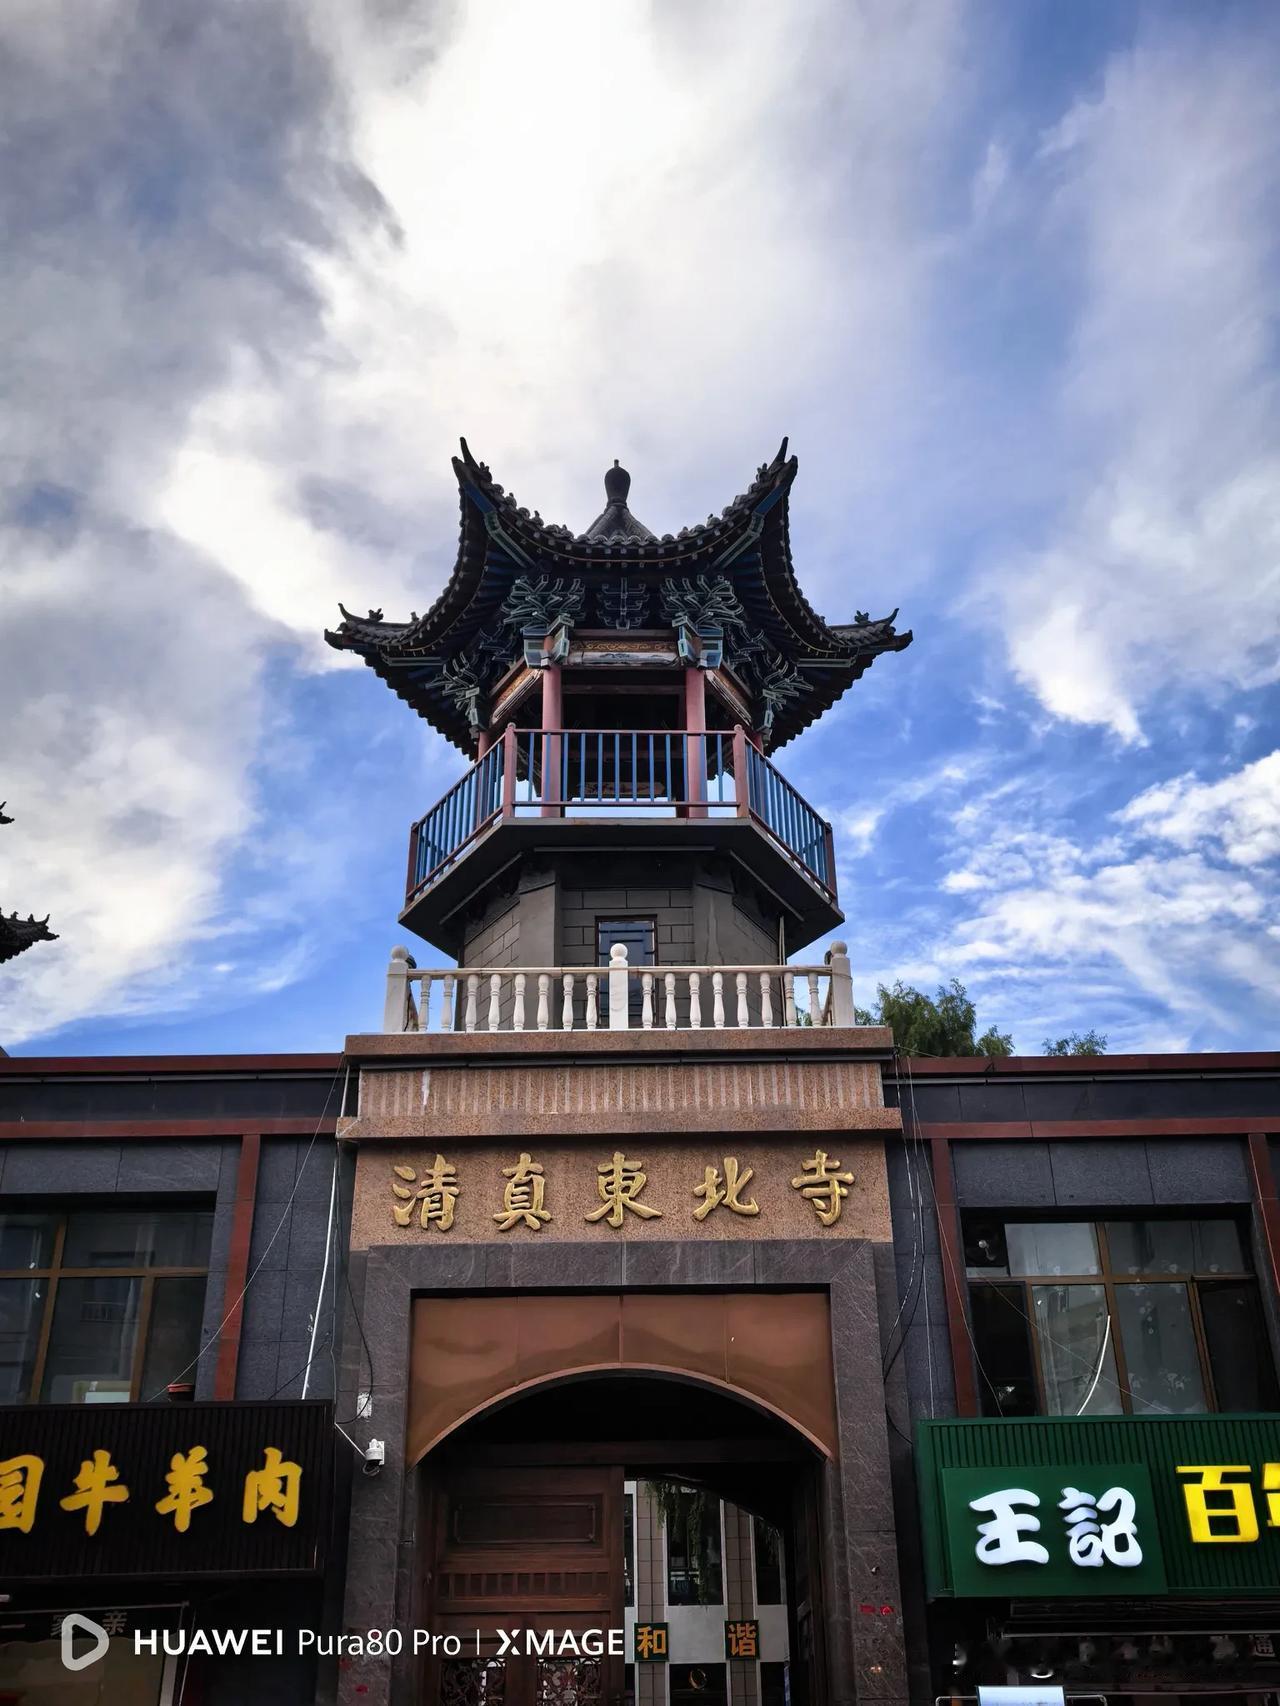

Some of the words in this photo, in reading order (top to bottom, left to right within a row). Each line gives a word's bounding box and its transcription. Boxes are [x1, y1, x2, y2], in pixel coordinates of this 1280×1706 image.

[393, 1149, 855, 1232] 清真東北寺
[969, 1486, 1143, 1567] 王記
[1175, 1462, 1280, 1543] 百
[636, 1623, 757, 1658] 和谐
